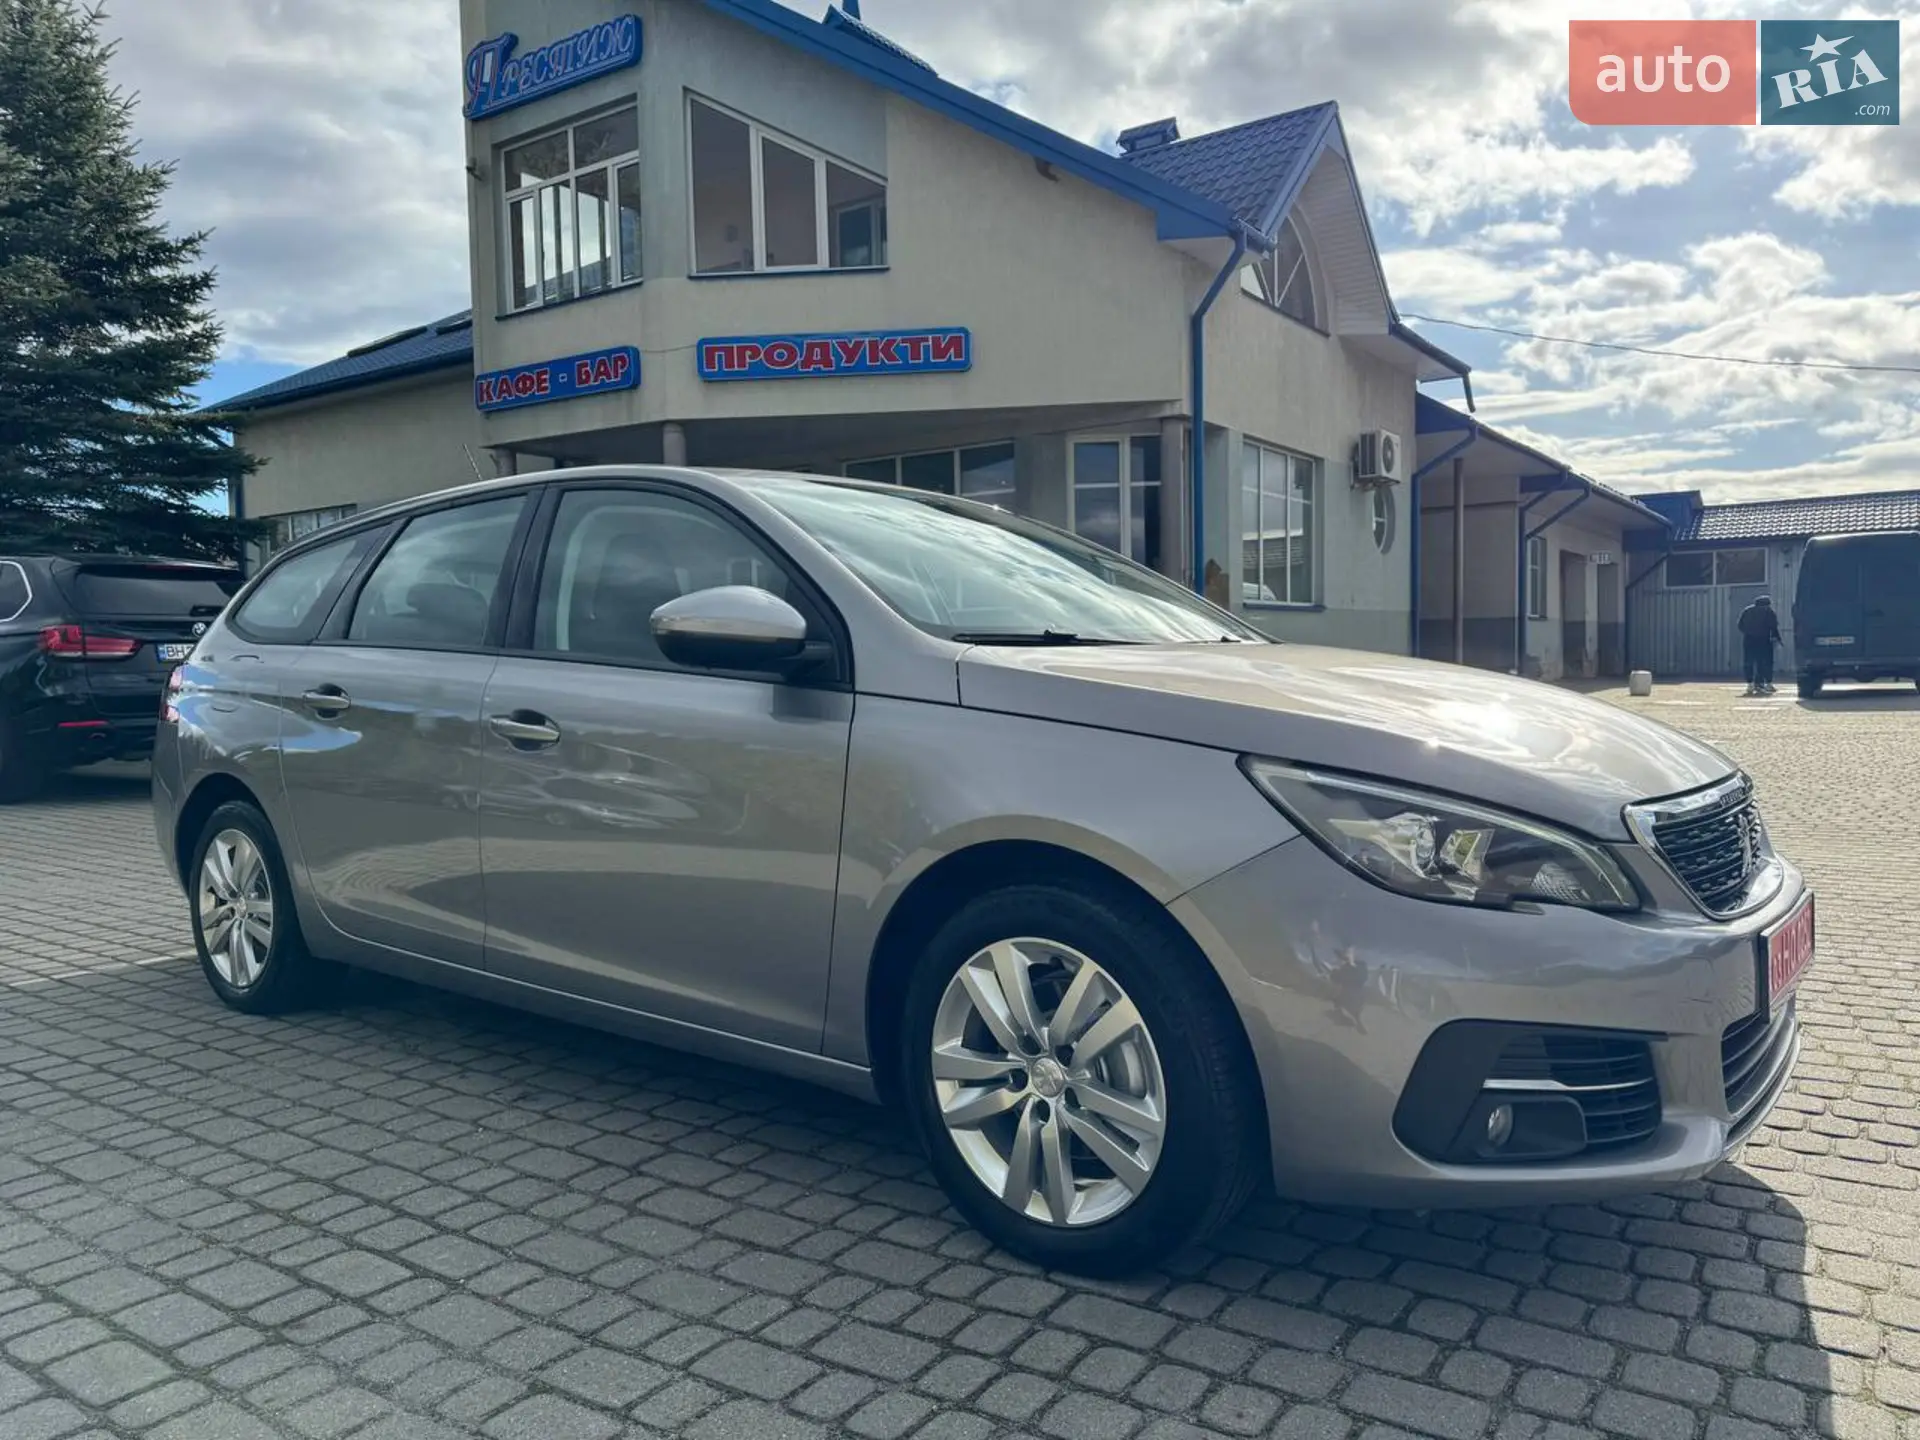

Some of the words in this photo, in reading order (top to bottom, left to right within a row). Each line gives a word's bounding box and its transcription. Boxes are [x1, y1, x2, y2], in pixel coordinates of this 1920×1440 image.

[703, 333, 966, 372] ПРОДУКТИ
[477, 367, 551, 405] КАФЕ
[575, 352, 630, 388] БАР
